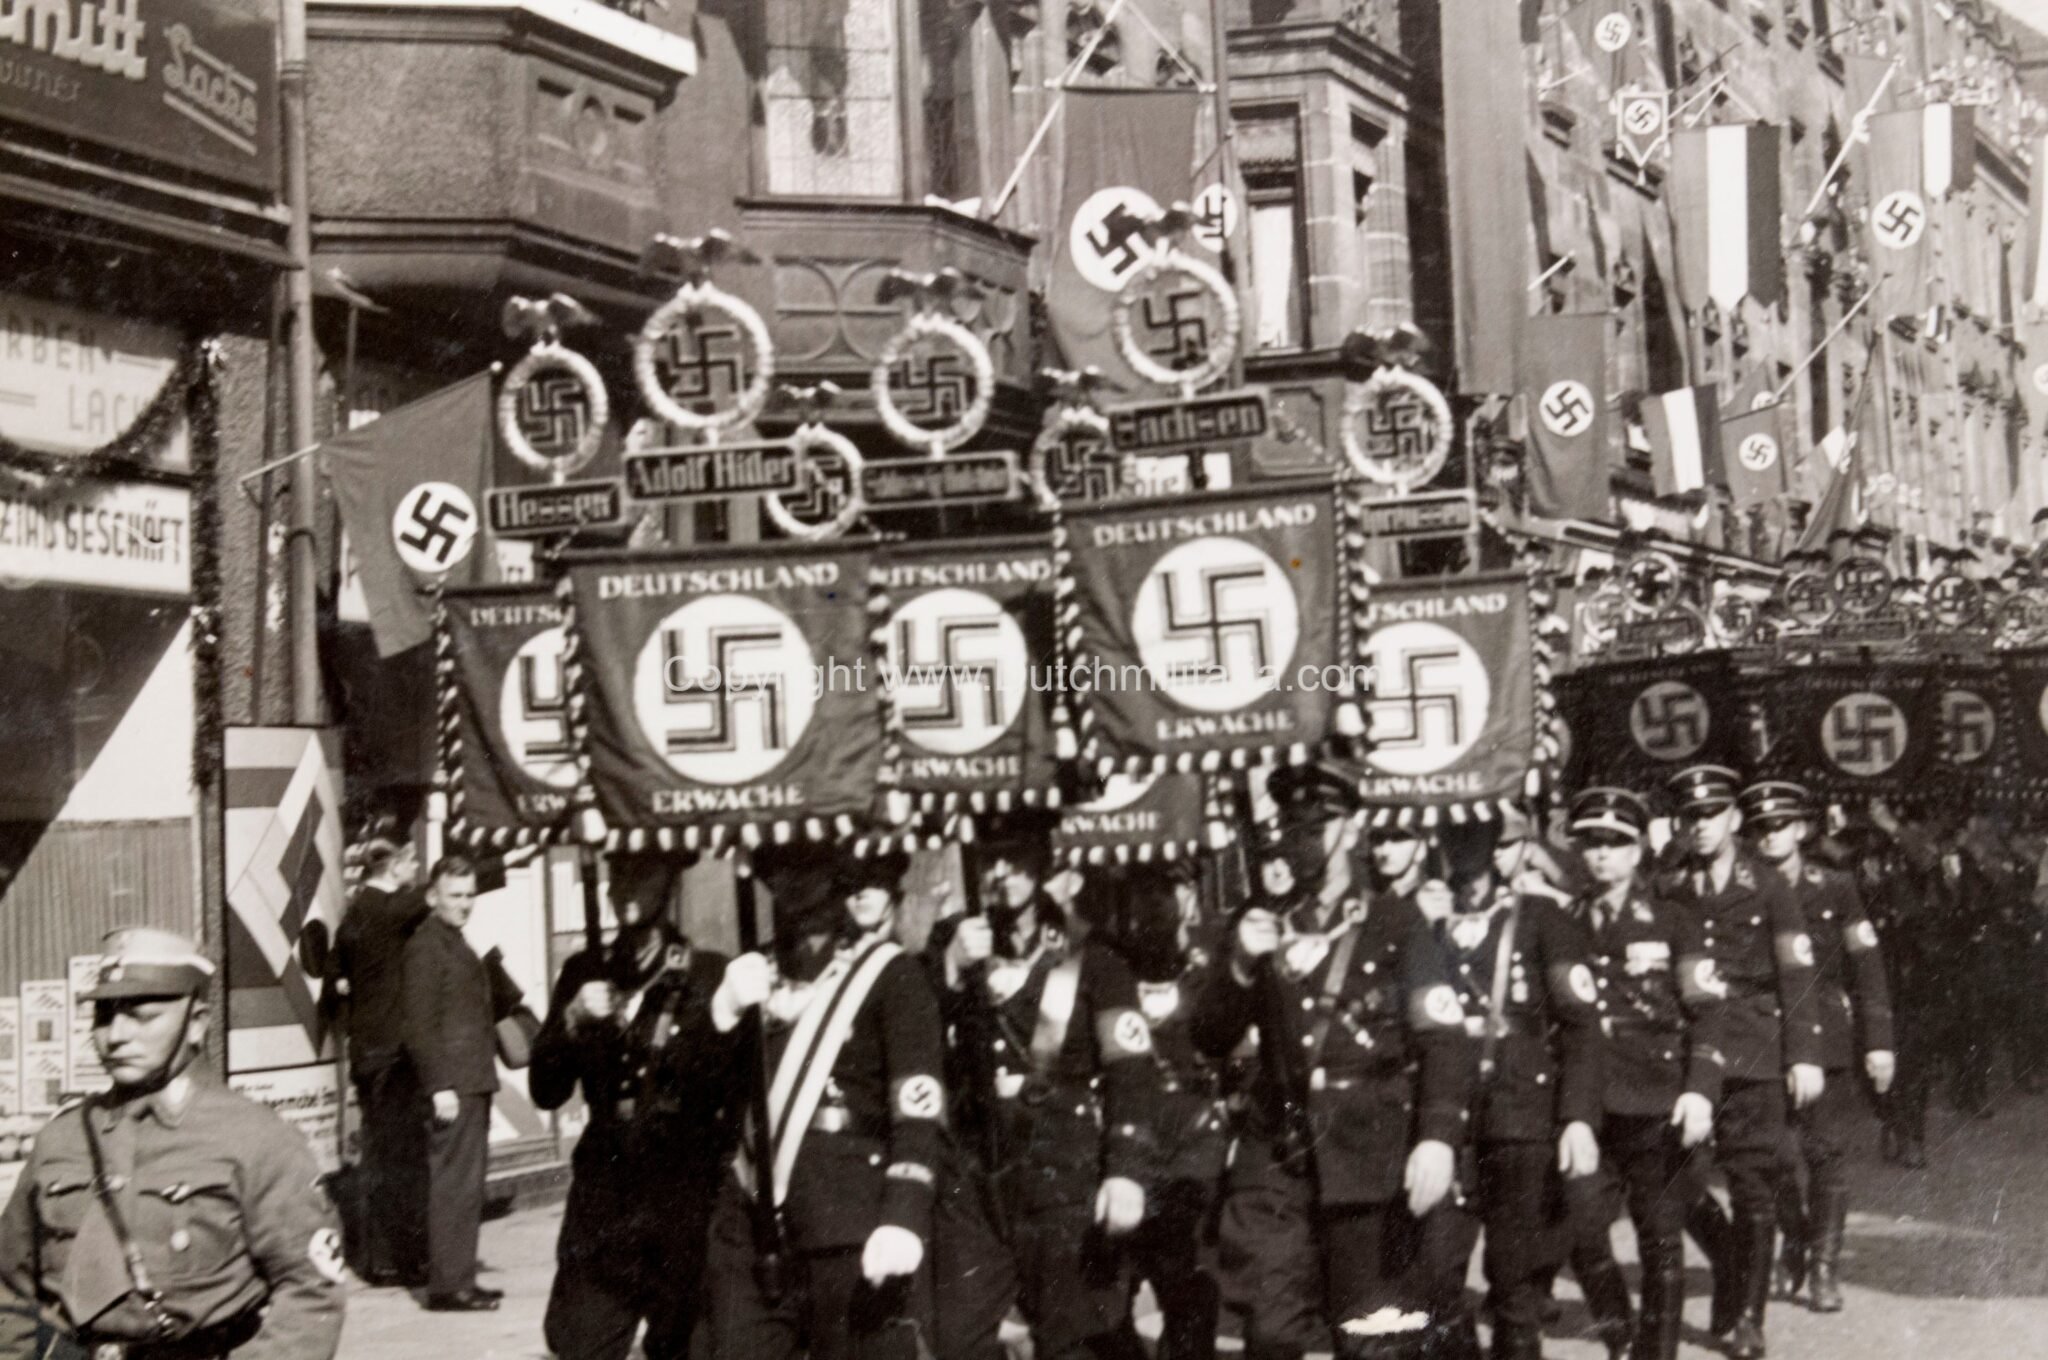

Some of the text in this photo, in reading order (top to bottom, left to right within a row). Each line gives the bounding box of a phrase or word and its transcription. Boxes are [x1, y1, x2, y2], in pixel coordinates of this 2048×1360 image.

[0, 0, 147, 80] mitt
[1093, 503, 1317, 547] DEUTSCHLAND
[598, 562, 839, 599] DEUTSCHLAND
[1157, 709, 1295, 741] ERWACHE
[652, 784, 804, 814] ERWACHE
